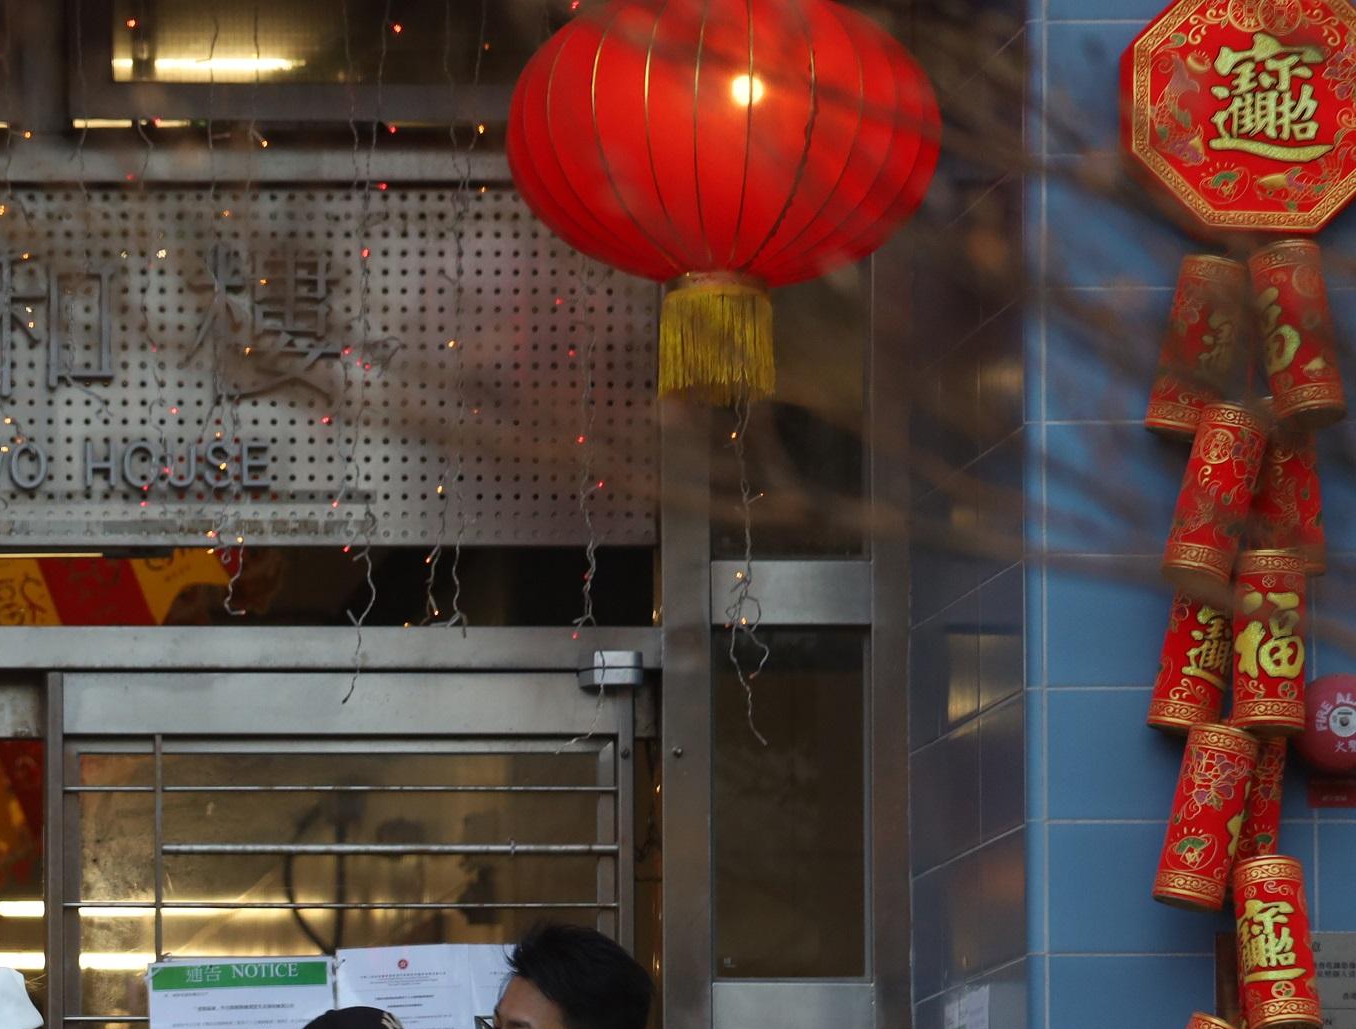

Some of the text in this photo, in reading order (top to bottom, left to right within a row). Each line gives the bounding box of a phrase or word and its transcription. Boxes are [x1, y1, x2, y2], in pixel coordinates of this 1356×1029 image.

[84, 439, 272, 489] HOUSE
[1234, 591, 1305, 679] 福
[1315, 700, 1334, 732] FIRE
[185, 965, 222, 983] 通告
[232, 963, 299, 979] NOTICE
